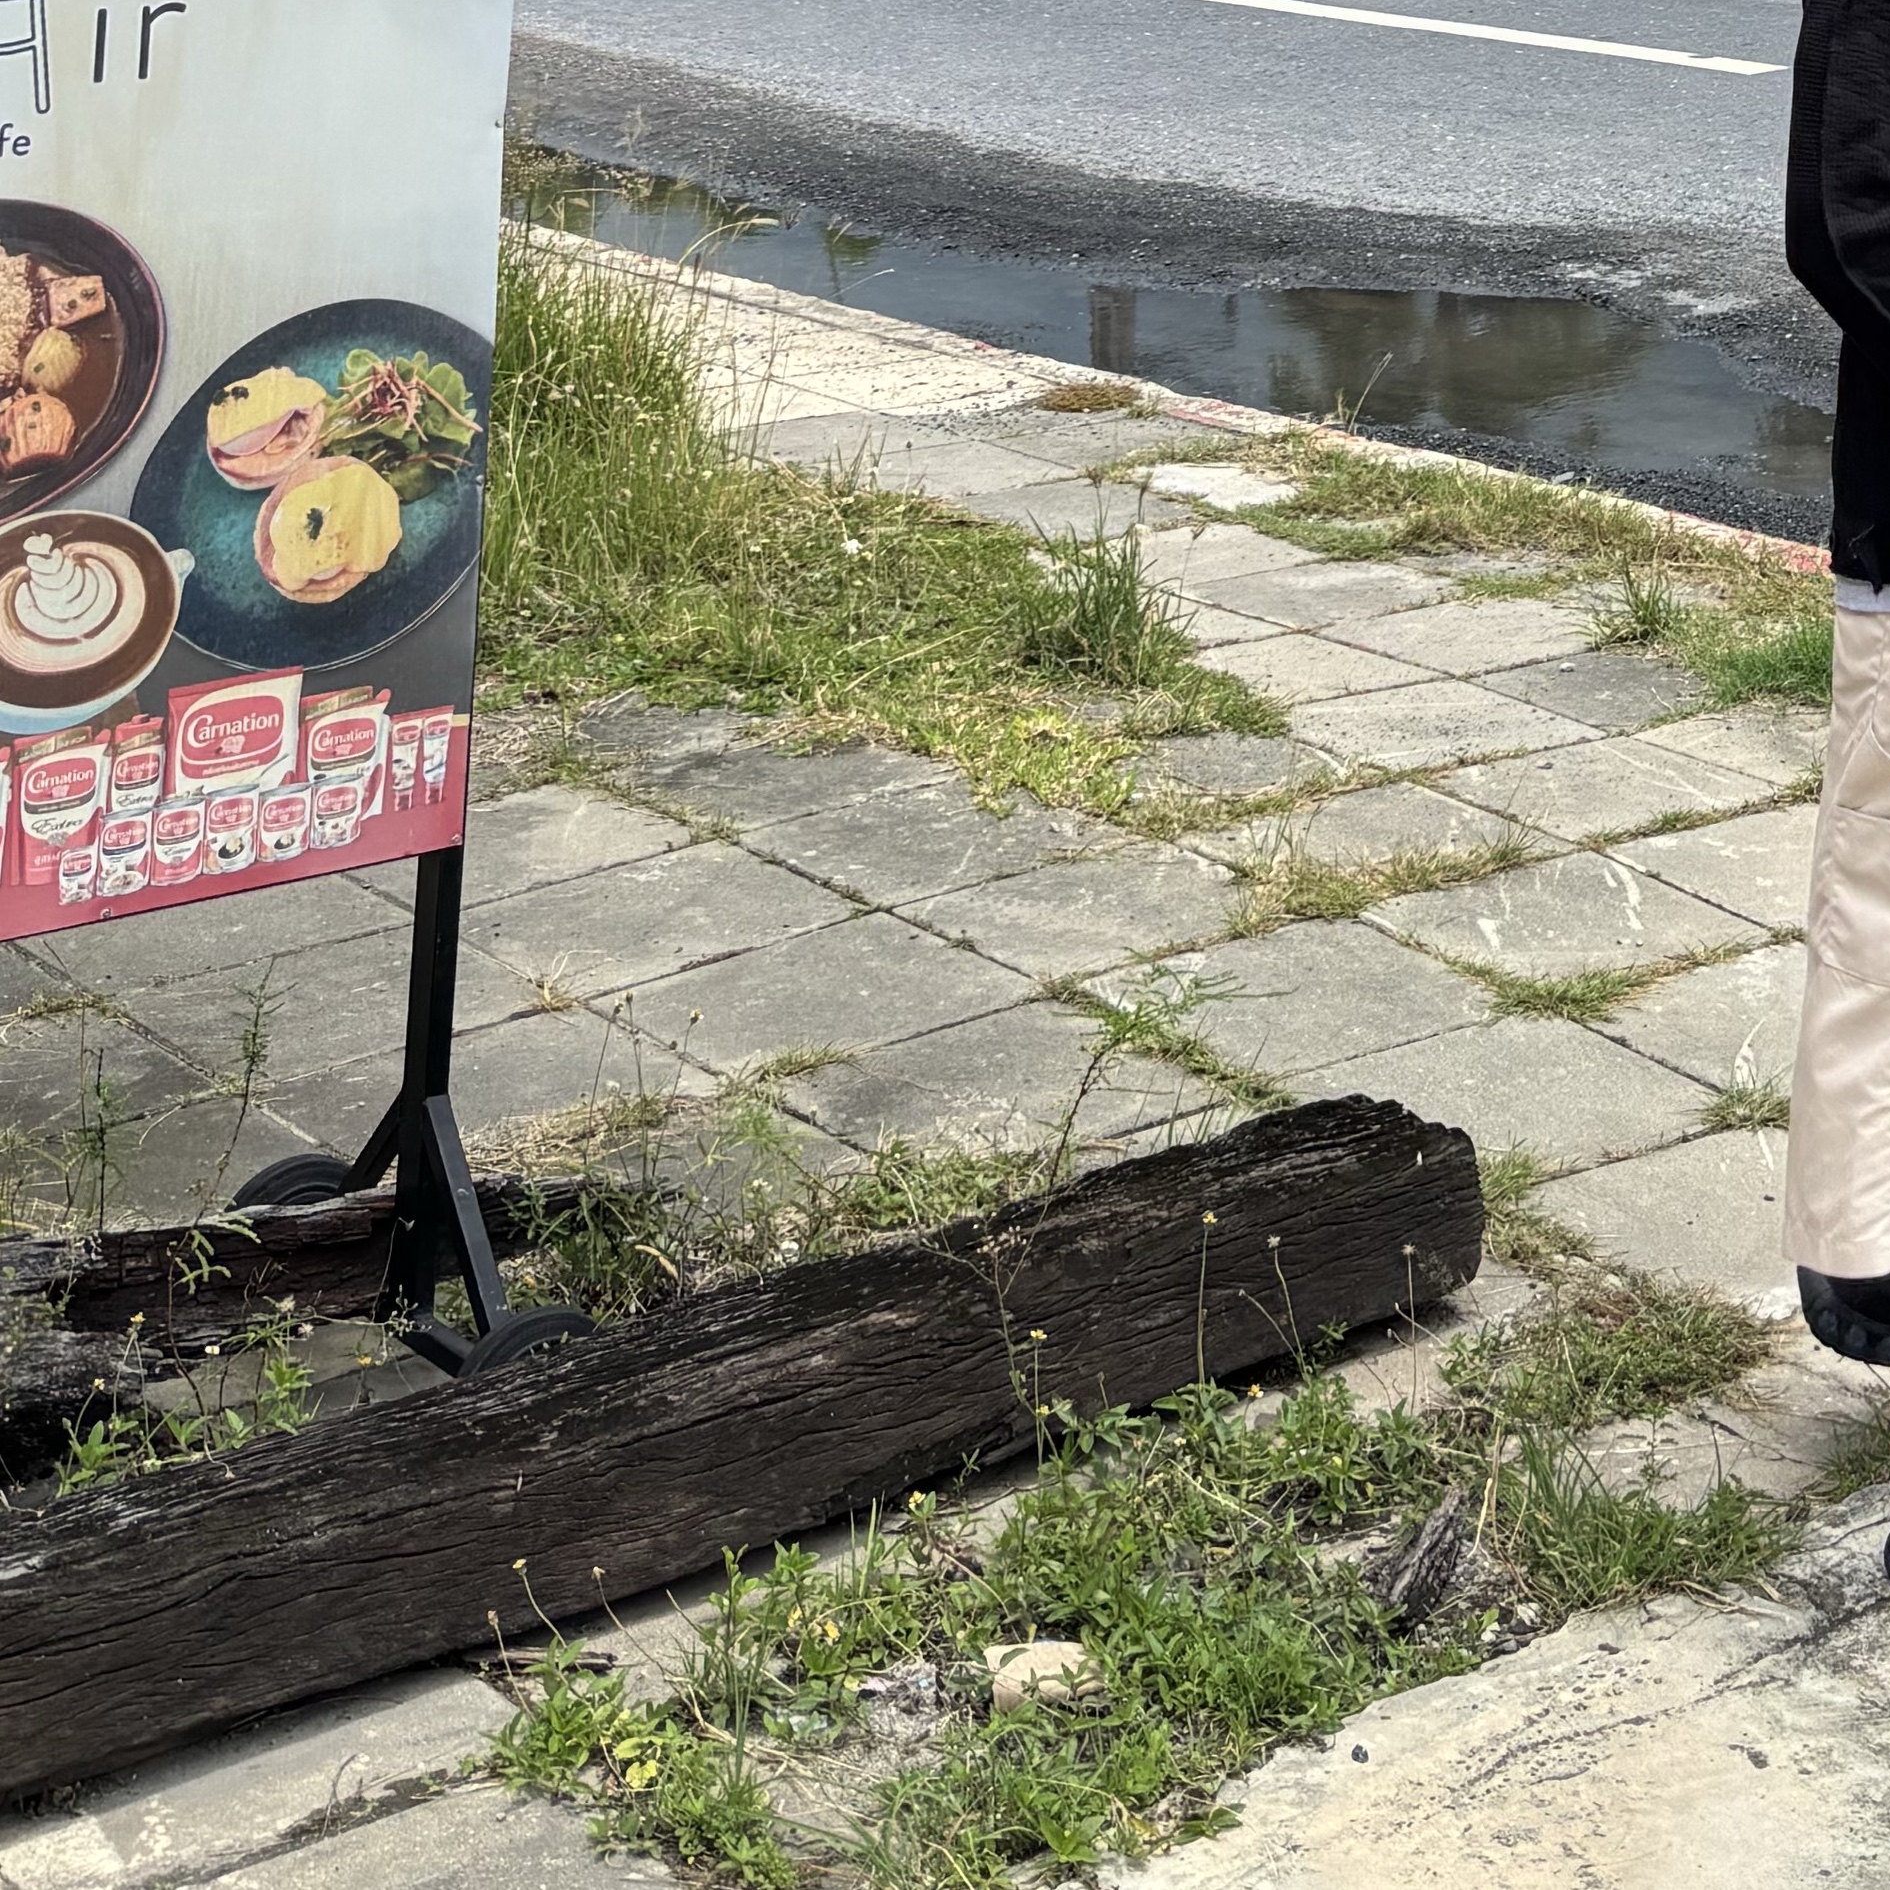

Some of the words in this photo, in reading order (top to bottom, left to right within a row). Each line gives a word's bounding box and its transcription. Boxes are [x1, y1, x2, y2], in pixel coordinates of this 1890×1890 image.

[187, 712, 280, 748] Carnation
[314, 728, 375, 752] Carnation
[28, 768, 95, 794] Carnation
